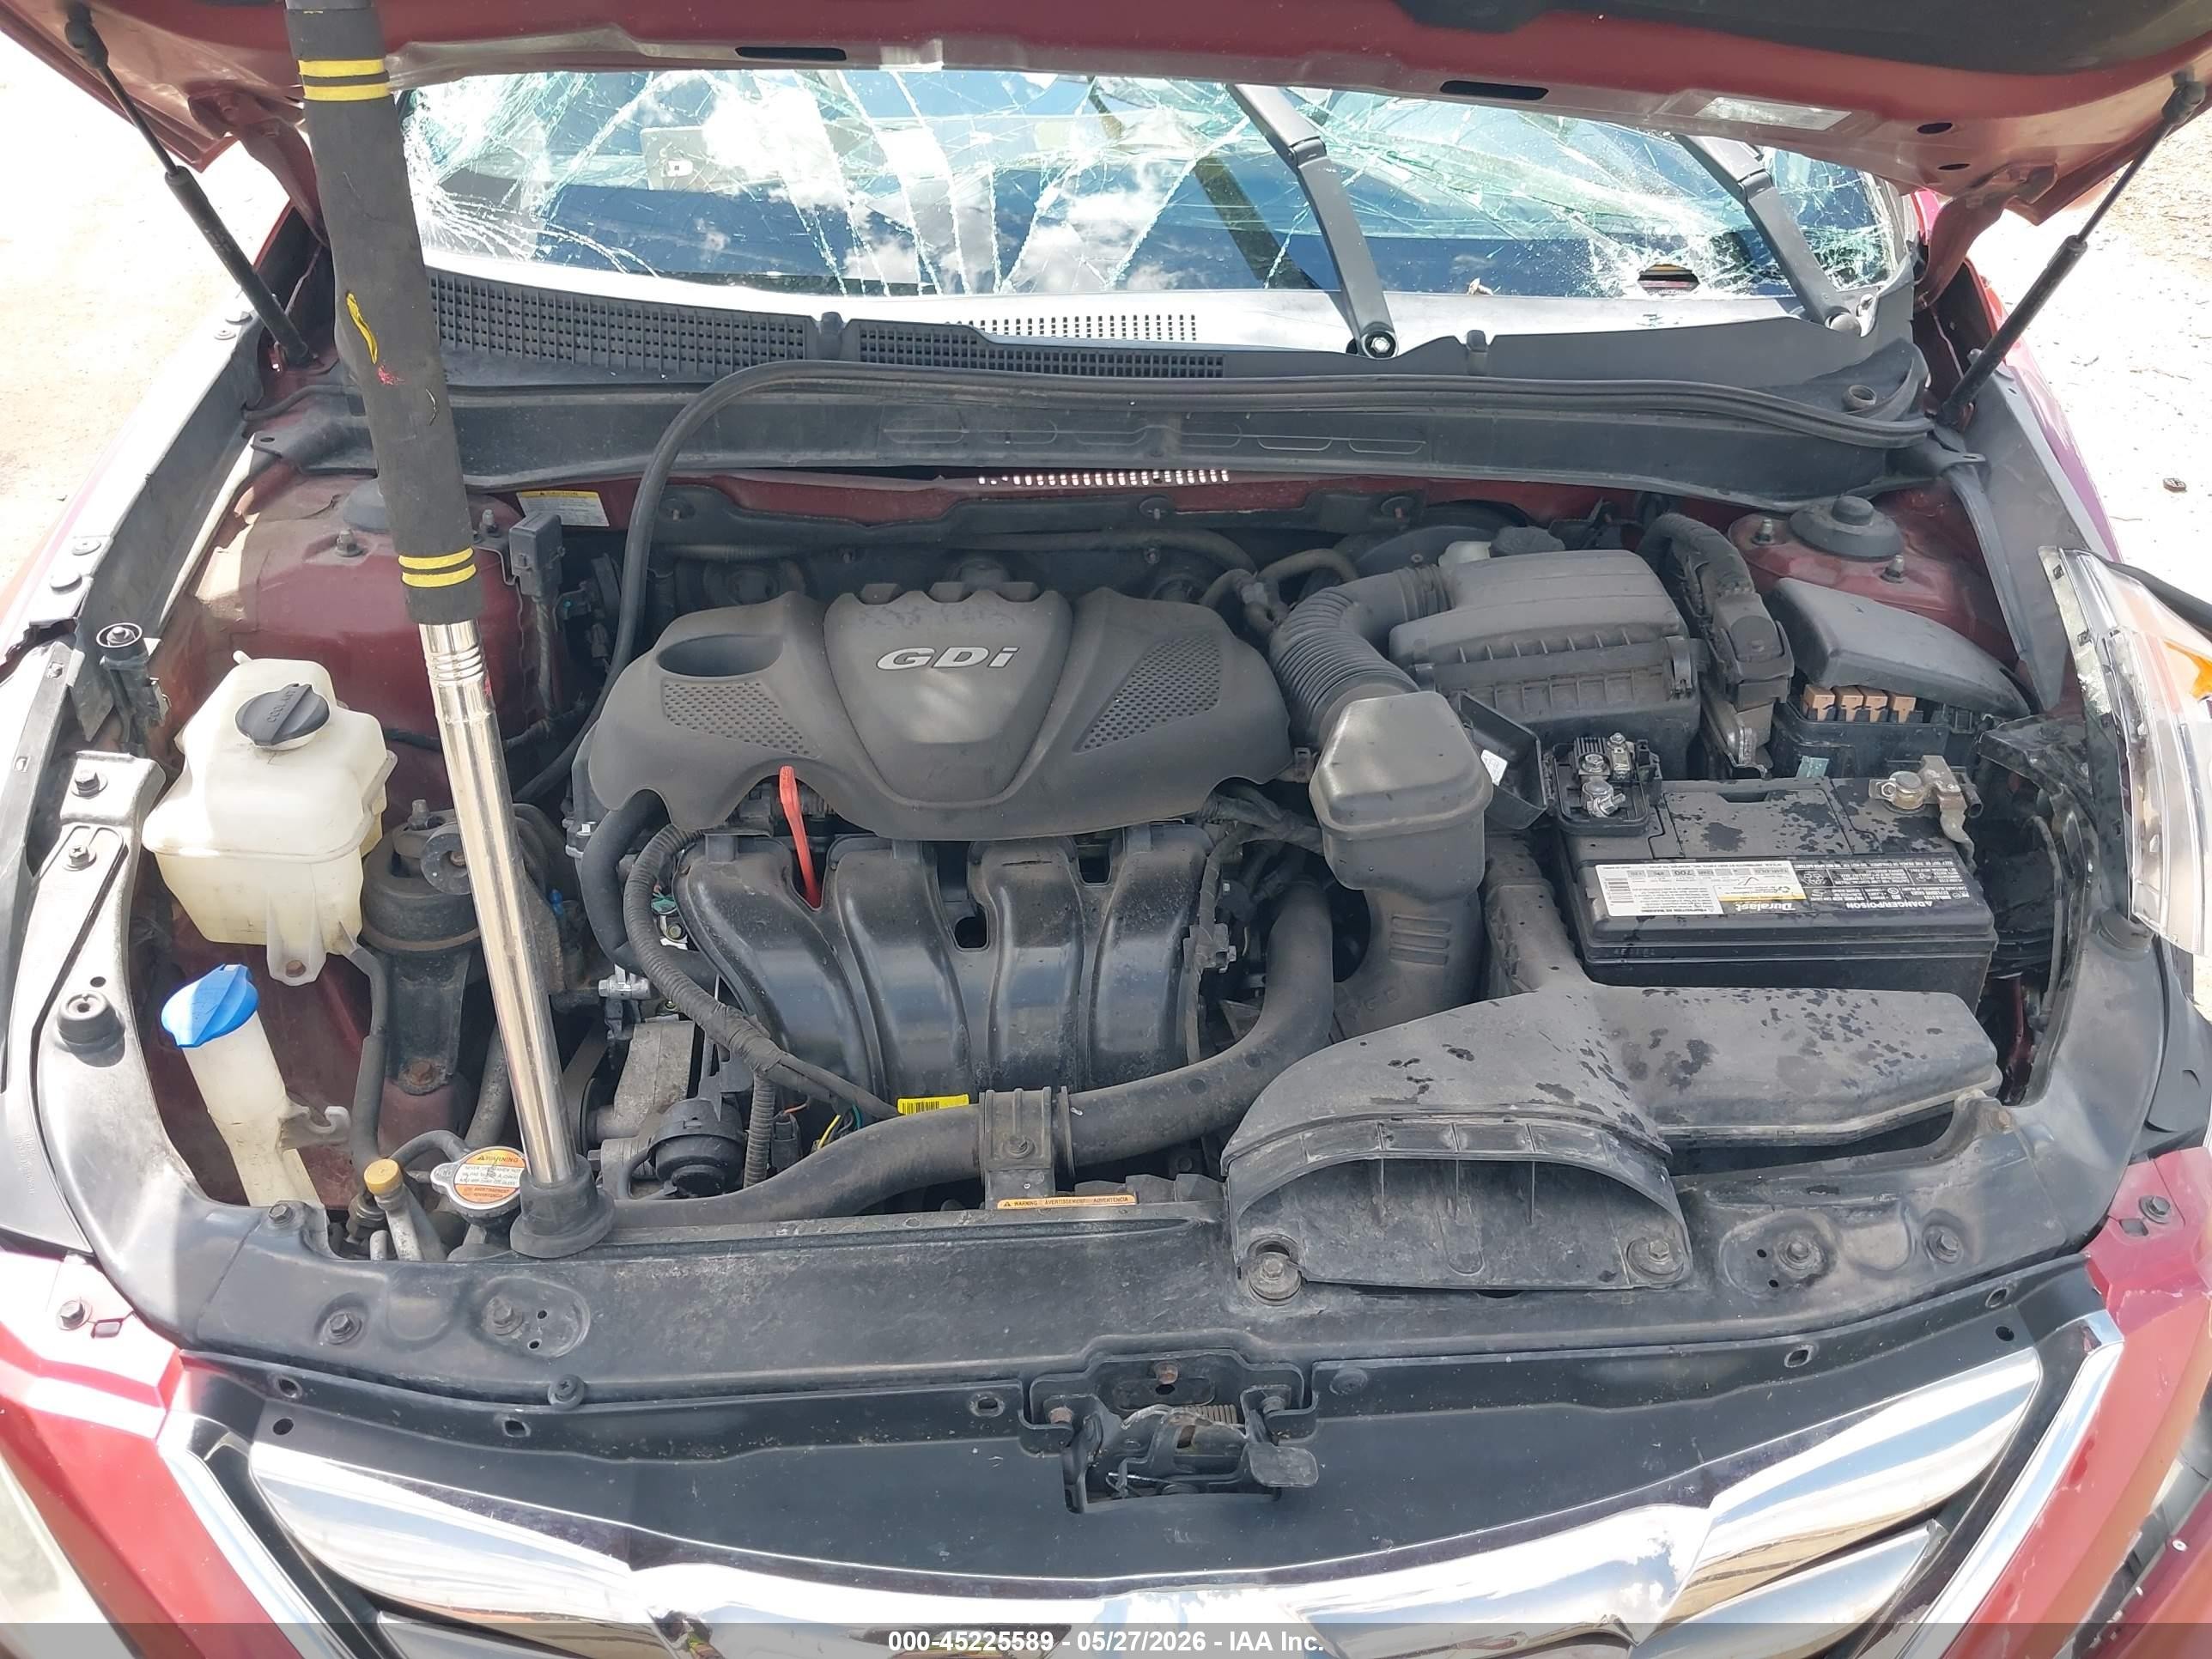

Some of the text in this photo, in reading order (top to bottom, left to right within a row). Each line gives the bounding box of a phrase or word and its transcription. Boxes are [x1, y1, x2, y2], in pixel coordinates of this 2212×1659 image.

[876, 646, 1020, 671] GDi
[1735, 902, 1796, 912] Duralast
[1846, 901, 1925, 909] DANGER/POISON
